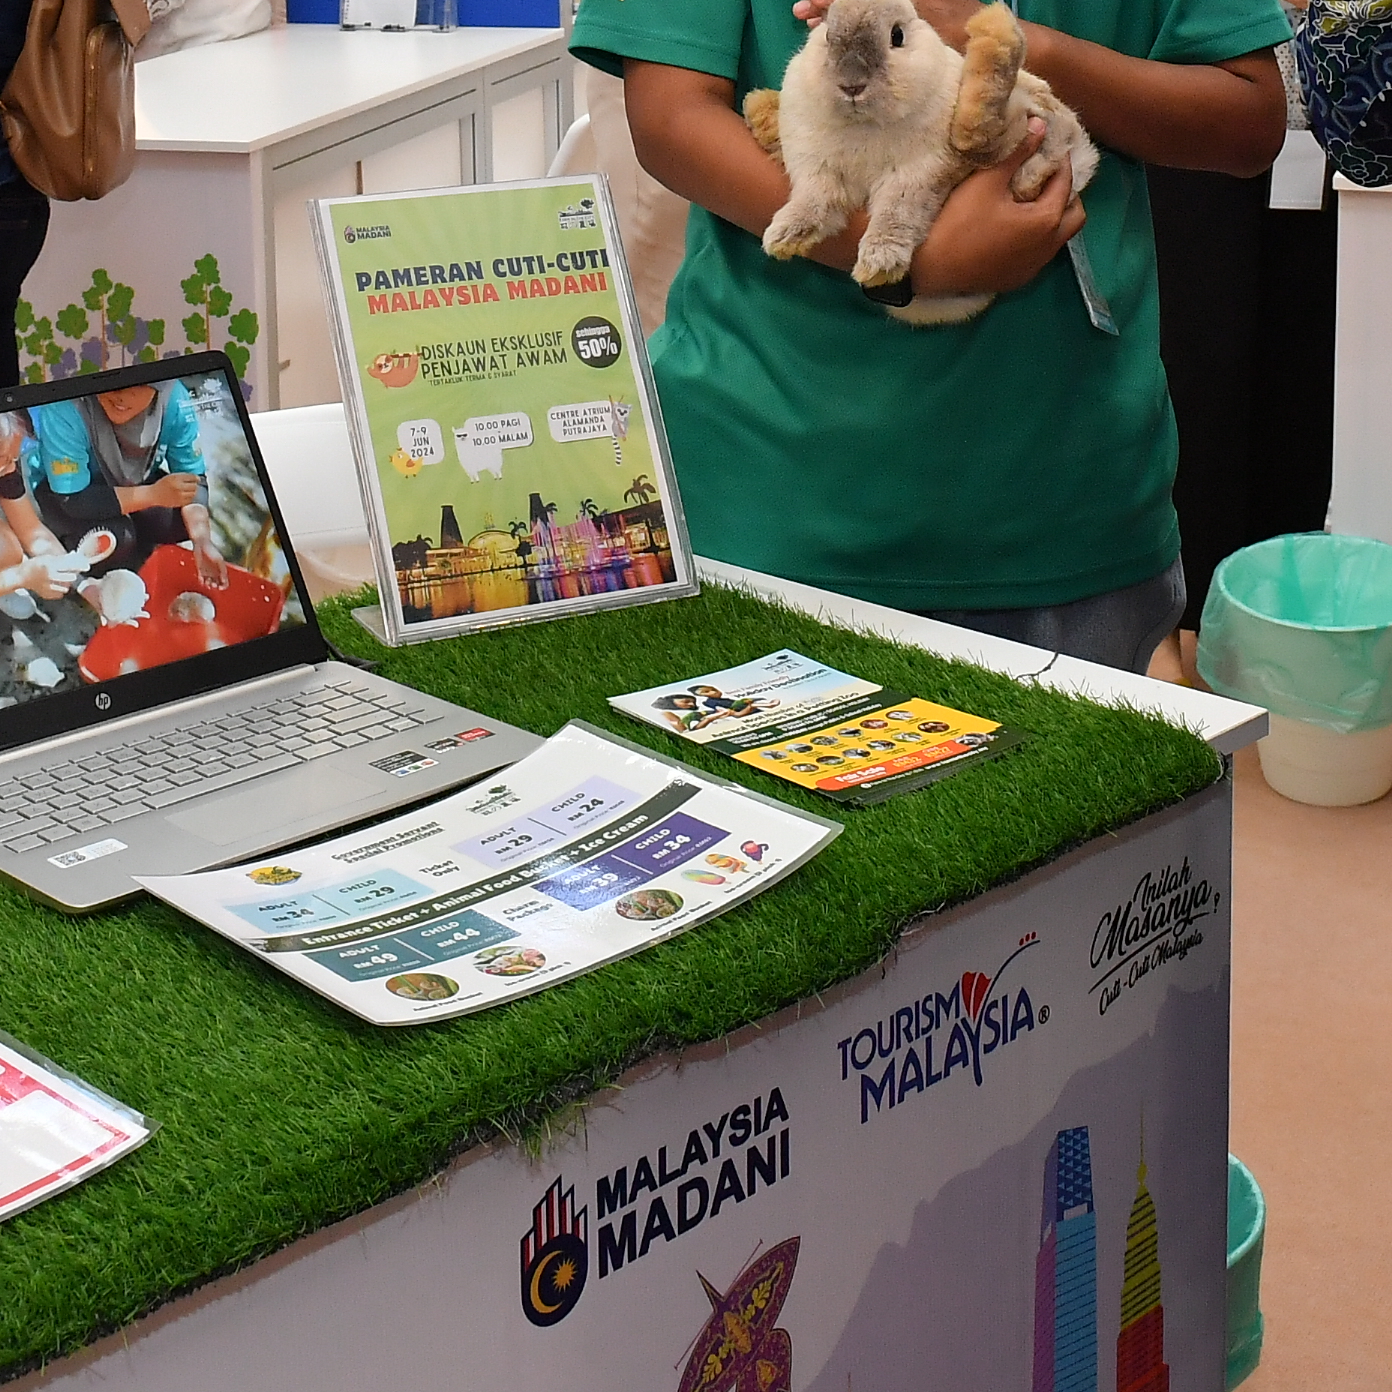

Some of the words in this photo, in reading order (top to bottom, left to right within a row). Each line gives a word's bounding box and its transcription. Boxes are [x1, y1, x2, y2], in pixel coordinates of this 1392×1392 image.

[356, 225, 390, 234] MALAYSIA
[357, 231, 392, 241] MADANI
[355, 261, 484, 292] PAMERAN
[492, 249, 609, 278] CUTI-CUTI
[367, 283, 500, 315] MALAYSIA
[506, 272, 607, 300] MADANI
[421, 339, 486, 361] DISKAUN
[491, 331, 563, 352] EKSKLUSIF
[578, 336, 618, 360] 50%
[421, 353, 508, 379] PENJAWAT
[516, 348, 568, 368] AWAM
[465, 373, 486, 381] TERMA
[494, 370, 517, 379] SYARAT
[550, 410, 580, 421] CENTRE
[582, 406, 611, 416] ATRIUM
[562, 416, 605, 427] ALAMANDA
[410, 427, 427, 437] 7-9
[475, 421, 499, 432] 10.00
[501, 419, 522, 429] PAGI
[562, 425, 608, 436] PUTRAJAYA
[412, 437, 430, 447] JUN
[472, 436, 496, 447] 10.00
[498, 432, 529, 443] MALAM
[410, 447, 435, 458] 2024
[551, 792, 586, 813] CHILD
[567, 812, 584, 822] RM
[583, 797, 604, 814] 24
[331, 836, 395, 860] Government
[396, 821, 440, 839] Servant
[344, 847, 384, 864] Special
[384, 827, 446, 854] Promotions
[480, 827, 518, 846] ADULT
[495, 846, 511, 856] RM
[513, 834, 533, 849] 29
[635, 827, 672, 850] CHILD
[652, 849, 668, 861] RM
[668, 834, 691, 851] 34
[419, 860, 453, 874] Ticket
[432, 864, 460, 878] Only
[301, 924, 373, 946] Entrance
[372, 909, 417, 931] Ticket
[431, 885, 487, 913] Animal
[485, 870, 525, 895] Food
[580, 835, 605, 853] Ice
[605, 813, 649, 846] Cream
[338, 879, 377, 894] CHILD
[595, 873, 619, 888] 39
[1133, 856, 1192, 912] Inilah
[355, 896, 371, 905] RM
[373, 886, 395, 898] 29
[258, 900, 298, 912] ADULT
[272, 915, 290, 923] RM
[420, 921, 460, 938] CHILD
[437, 939, 455, 949] RM
[452, 928, 481, 943] 44
[338, 944, 381, 958] ADULT
[1151, 929, 1204, 970] Malaysia
[353, 960, 372, 970] RM
[371, 953, 398, 966] 49
[837, 980, 959, 1081] TOURISM
[861, 987, 1035, 1125] MALAYSIA
[597, 1087, 789, 1220] MALAYSIA
[598, 1127, 790, 1279] MADANI
